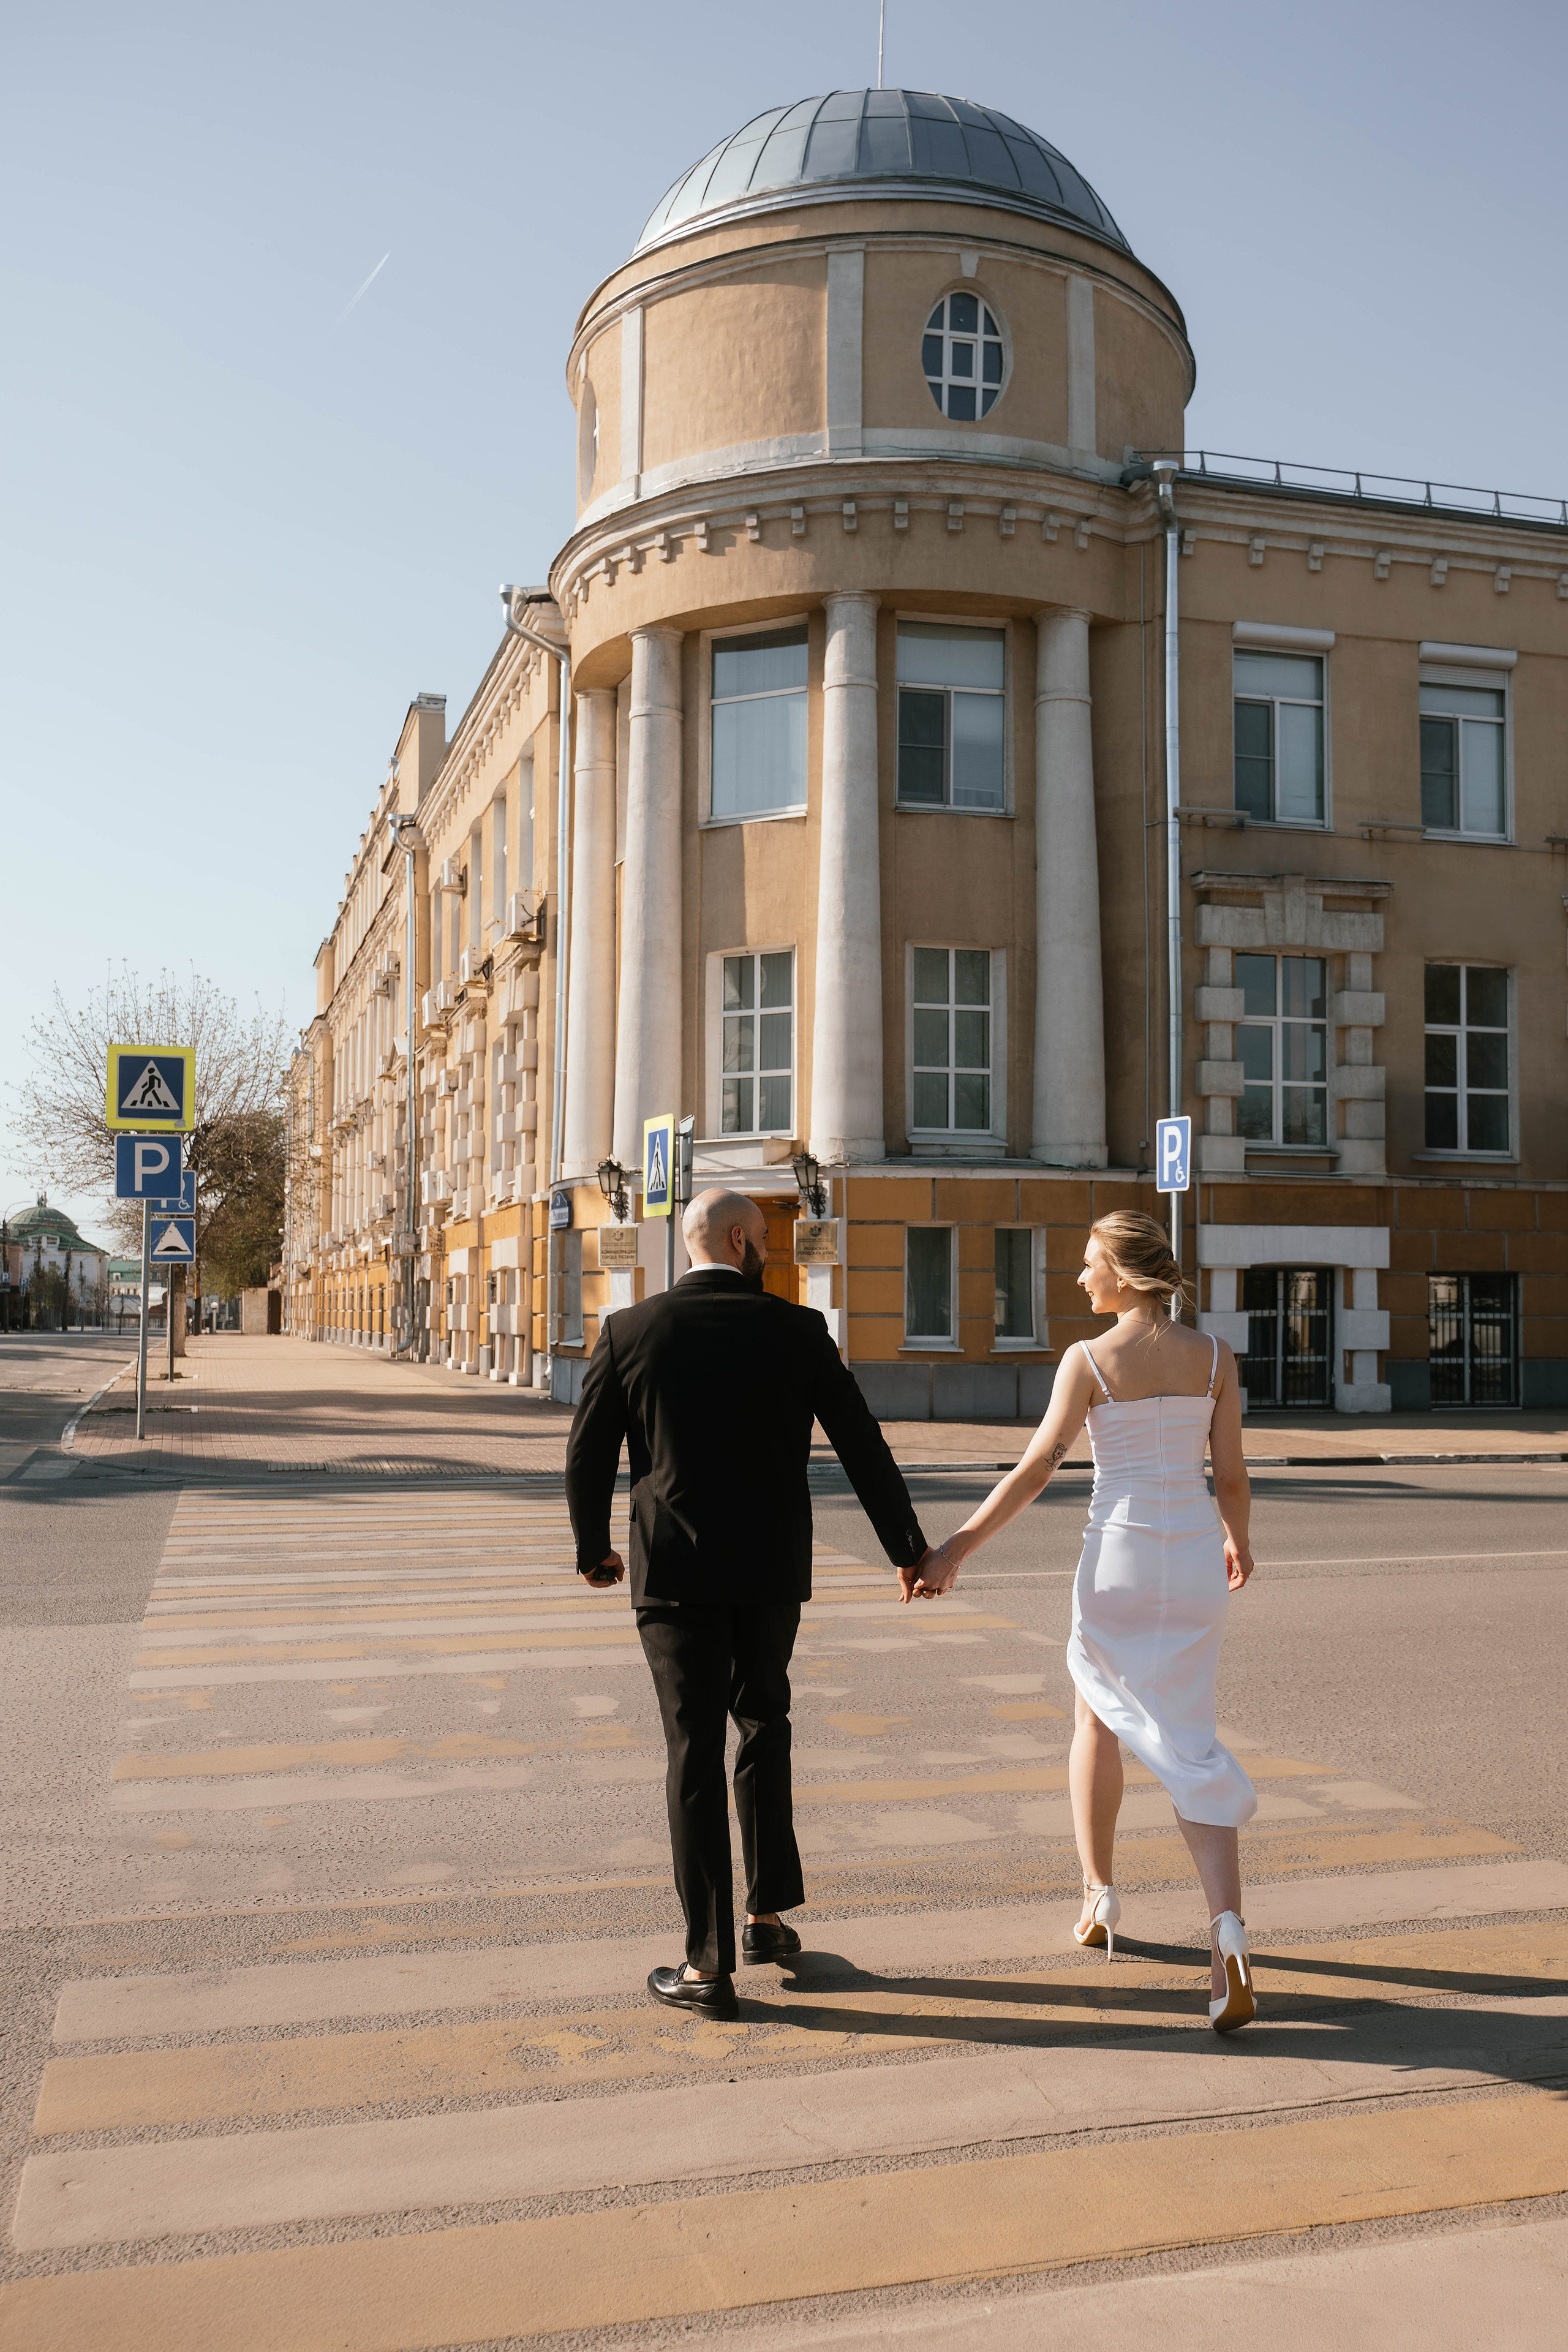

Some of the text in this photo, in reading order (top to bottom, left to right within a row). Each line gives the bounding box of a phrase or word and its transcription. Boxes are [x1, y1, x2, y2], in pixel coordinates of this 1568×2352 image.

[135, 1142, 170, 1191] P
[1164, 1125, 1182, 1182] P
[2, 1272, 9, 1282] P
[21, 1278, 28, 1286] P
